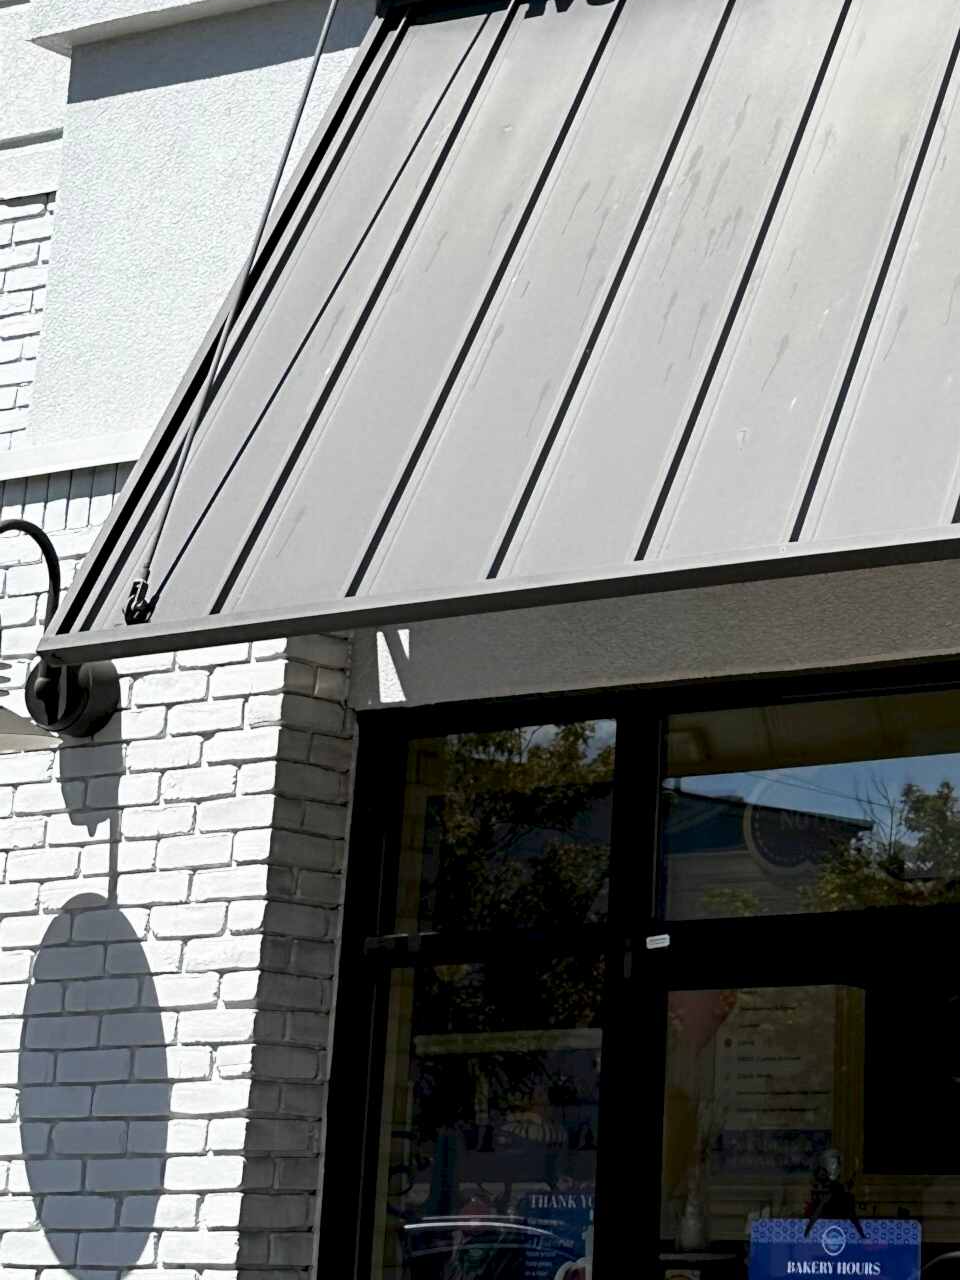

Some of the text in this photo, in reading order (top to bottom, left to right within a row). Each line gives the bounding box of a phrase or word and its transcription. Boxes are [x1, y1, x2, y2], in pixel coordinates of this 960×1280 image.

[529, 1193, 576, 1209] THANK
[786, 1259, 881, 1276] BAKERY HOURS
